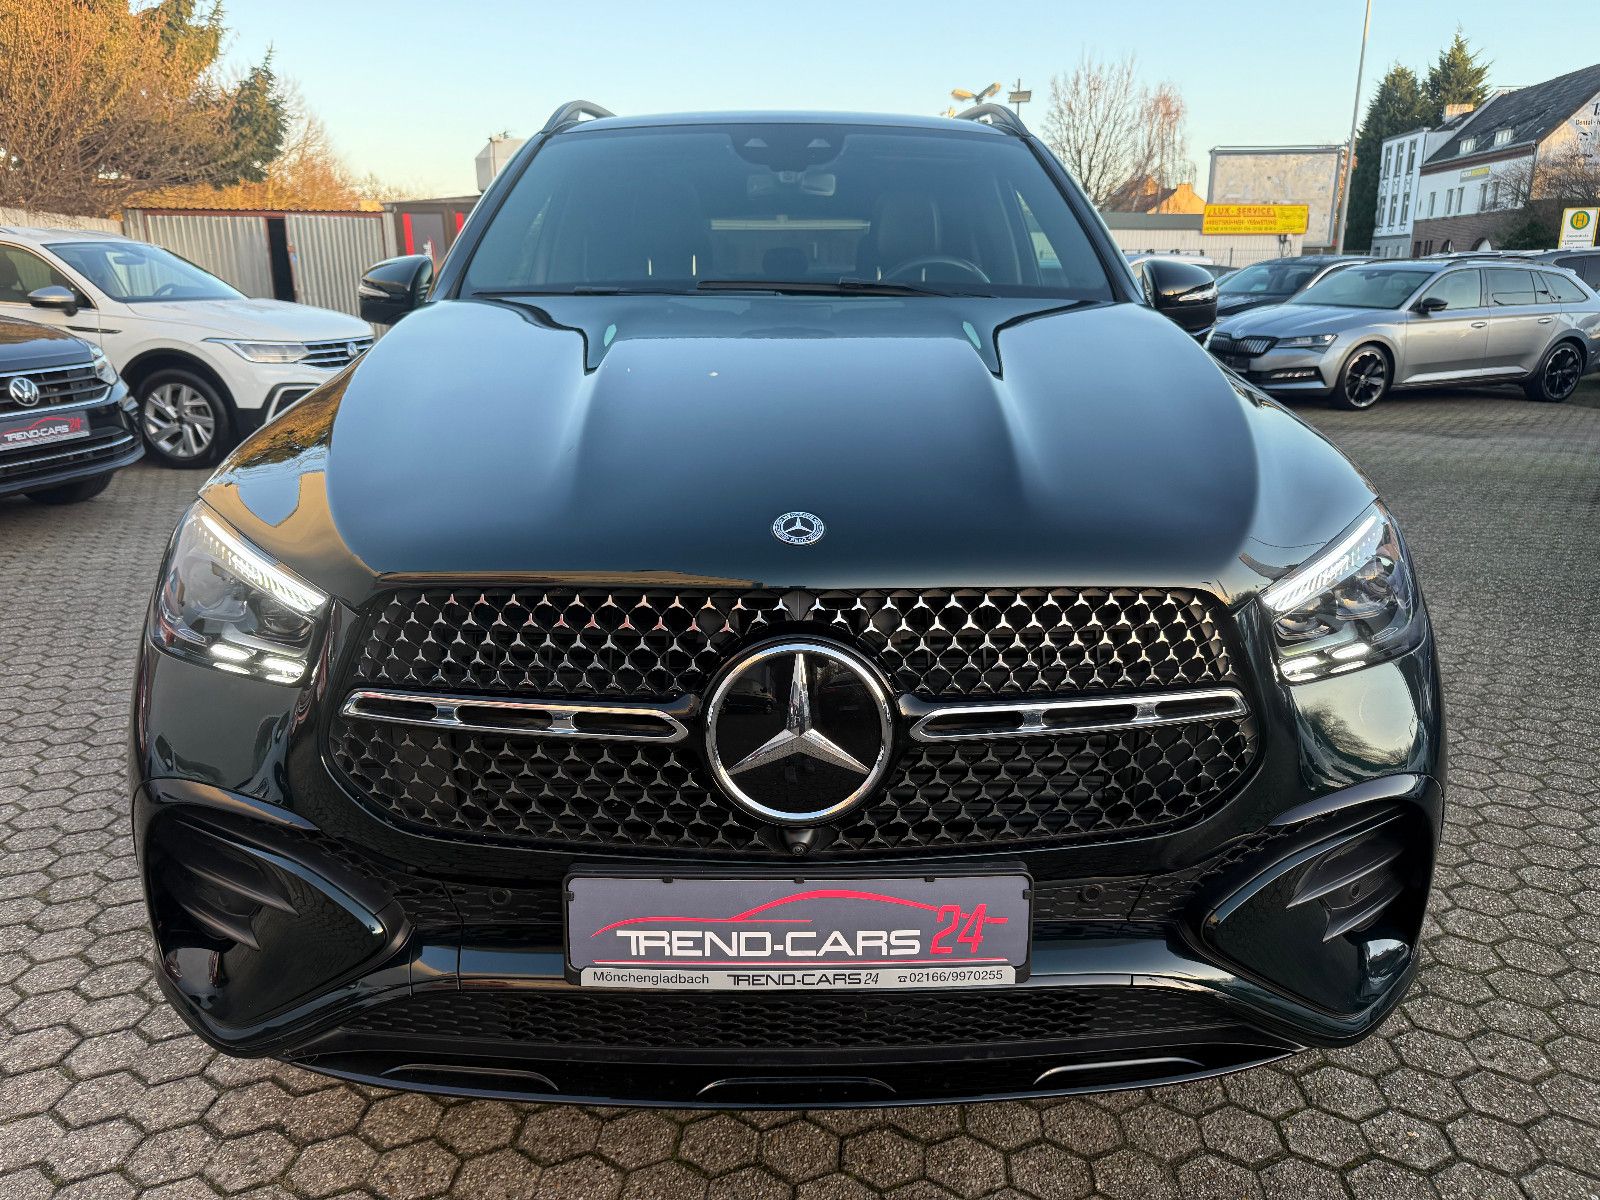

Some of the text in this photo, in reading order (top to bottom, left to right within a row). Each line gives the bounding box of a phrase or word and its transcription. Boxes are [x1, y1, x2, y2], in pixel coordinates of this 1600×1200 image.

[4, 424, 70, 442] TREND-CARS
[616, 903, 988, 957] TREND-CARS 24
[592, 970, 710, 986] Mönchengladbach
[726, 972, 862, 986] TREND-CARS
[908, 969, 1004, 983] 02166/9970255
